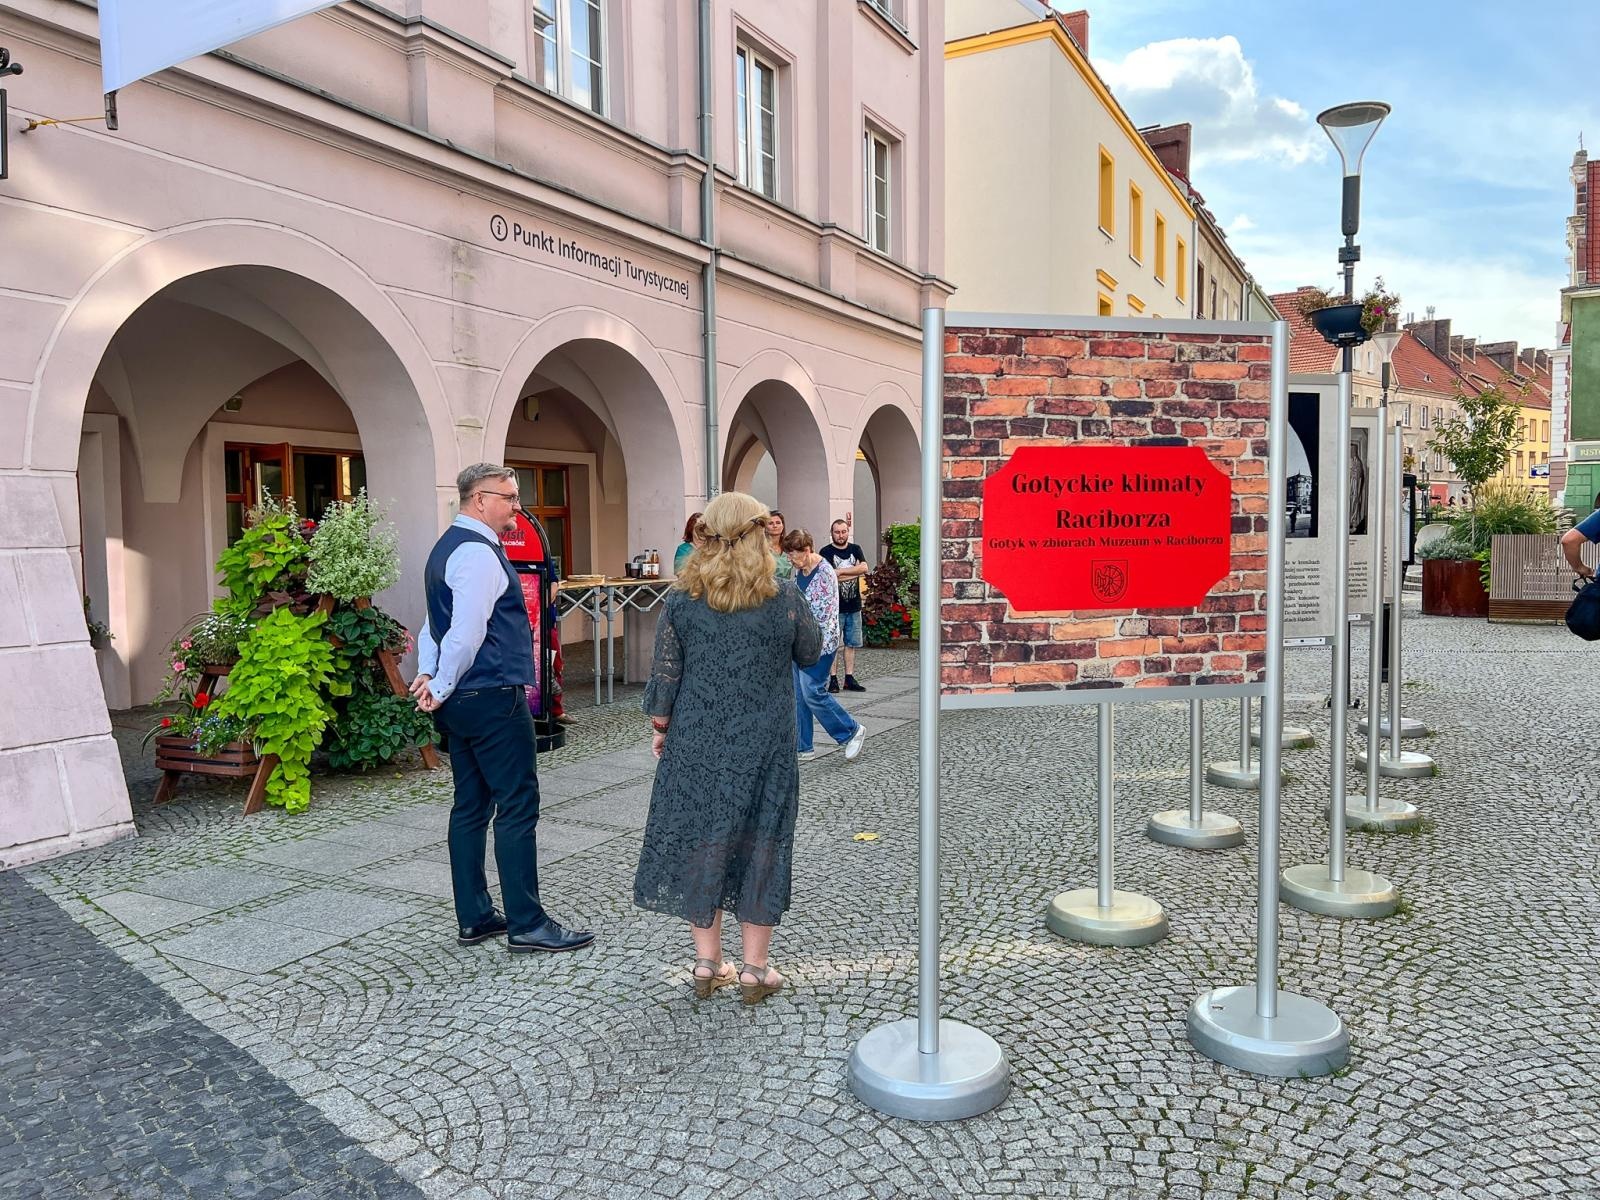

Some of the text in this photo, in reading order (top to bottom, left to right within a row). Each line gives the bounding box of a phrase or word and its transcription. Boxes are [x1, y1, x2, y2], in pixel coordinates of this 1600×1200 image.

[513, 222, 689, 300] Punkt Informacji Turystycznej
[1011, 473, 1206, 498] Gotyckie klimaty
[1056, 509, 1171, 529] Raciborza
[989, 537, 1025, 551] Gotyk
[1029, 540, 1038, 548] w
[1042, 536, 1096, 548] zbiorach
[1100, 536, 1150, 547] Muzeum
[1166, 535, 1224, 546] Raciborzu
